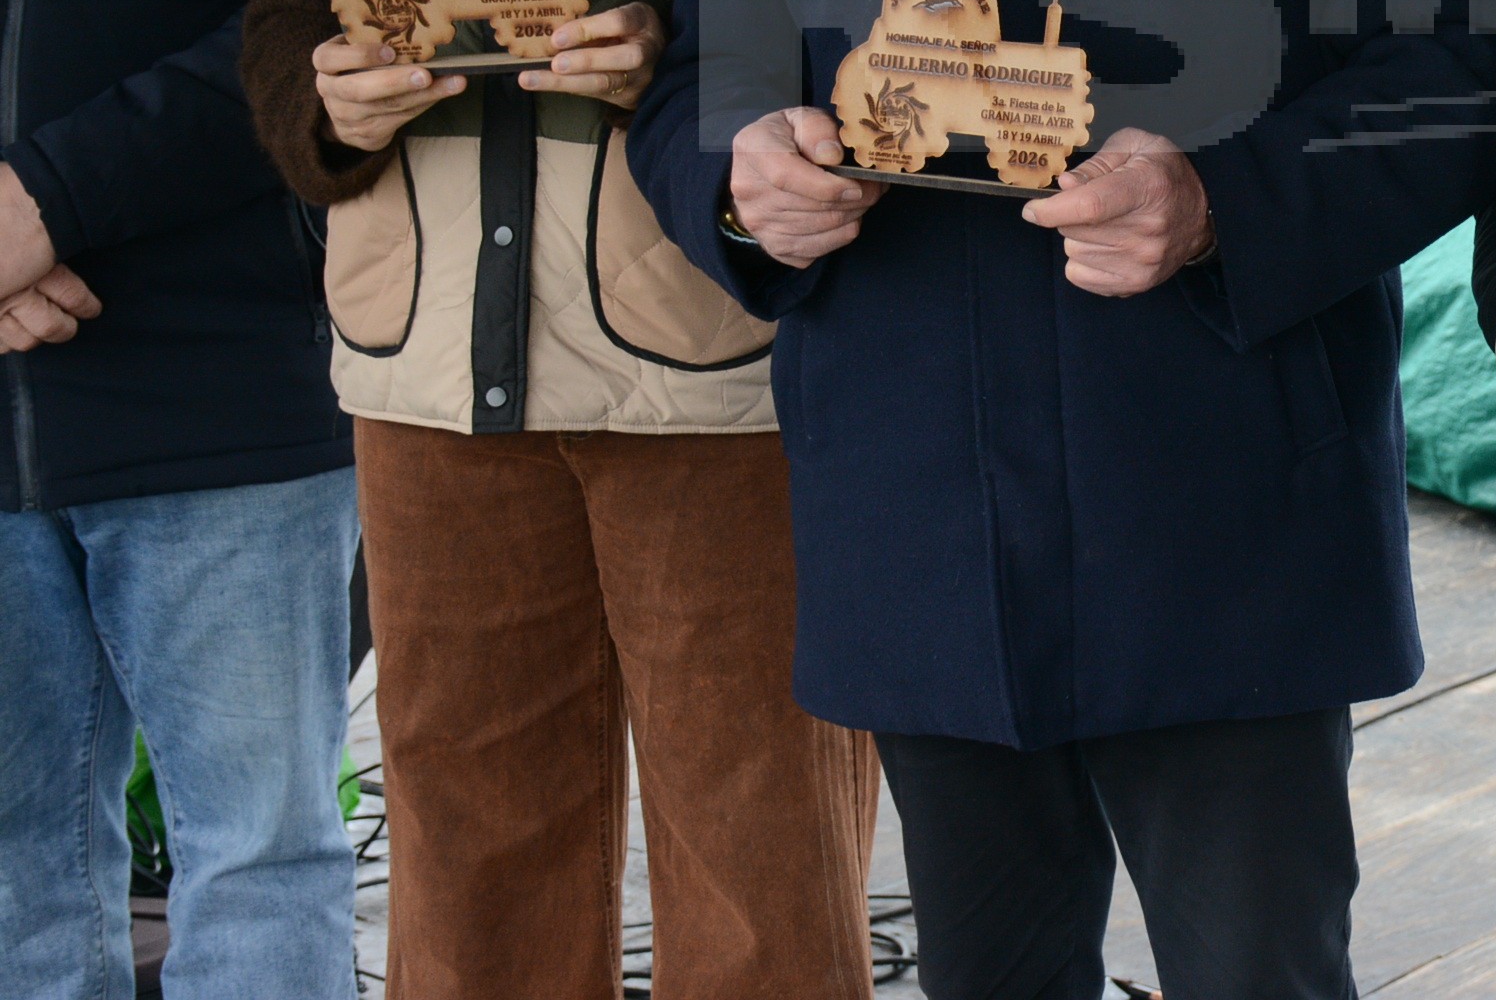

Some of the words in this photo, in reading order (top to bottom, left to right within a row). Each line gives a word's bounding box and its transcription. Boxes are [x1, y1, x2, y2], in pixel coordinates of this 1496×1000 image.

[500, 10, 512, 19] 18
[514, 9, 521, 18] Y
[522, 9, 534, 18] 19
[536, 7, 566, 17] ABRIL
[514, 24, 553, 38] 2026
[886, 33, 942, 47] HOMENAJE
[944, 39, 957, 48] AL
[960, 40, 996, 52] SEÑOR
[869, 53, 968, 77] GUILLERMO
[972, 64, 1074, 88] RODRIGUEZ
[992, 96, 1007, 106] 3a.
[1010, 97, 1038, 110] Fiesta
[1041, 101, 1053, 112] de
[1056, 102, 1065, 113] la
[981, 109, 1020, 124] GRANJA
[1023, 113, 1044, 125] DEL
[1046, 116, 1074, 128] AYER
[997, 130, 1009, 139] 18
[1010, 132, 1018, 140] Y
[1019, 133, 1031, 142] 19
[1033, 134, 1063, 146] ABRIL
[1007, 150, 1048, 167] 2026
